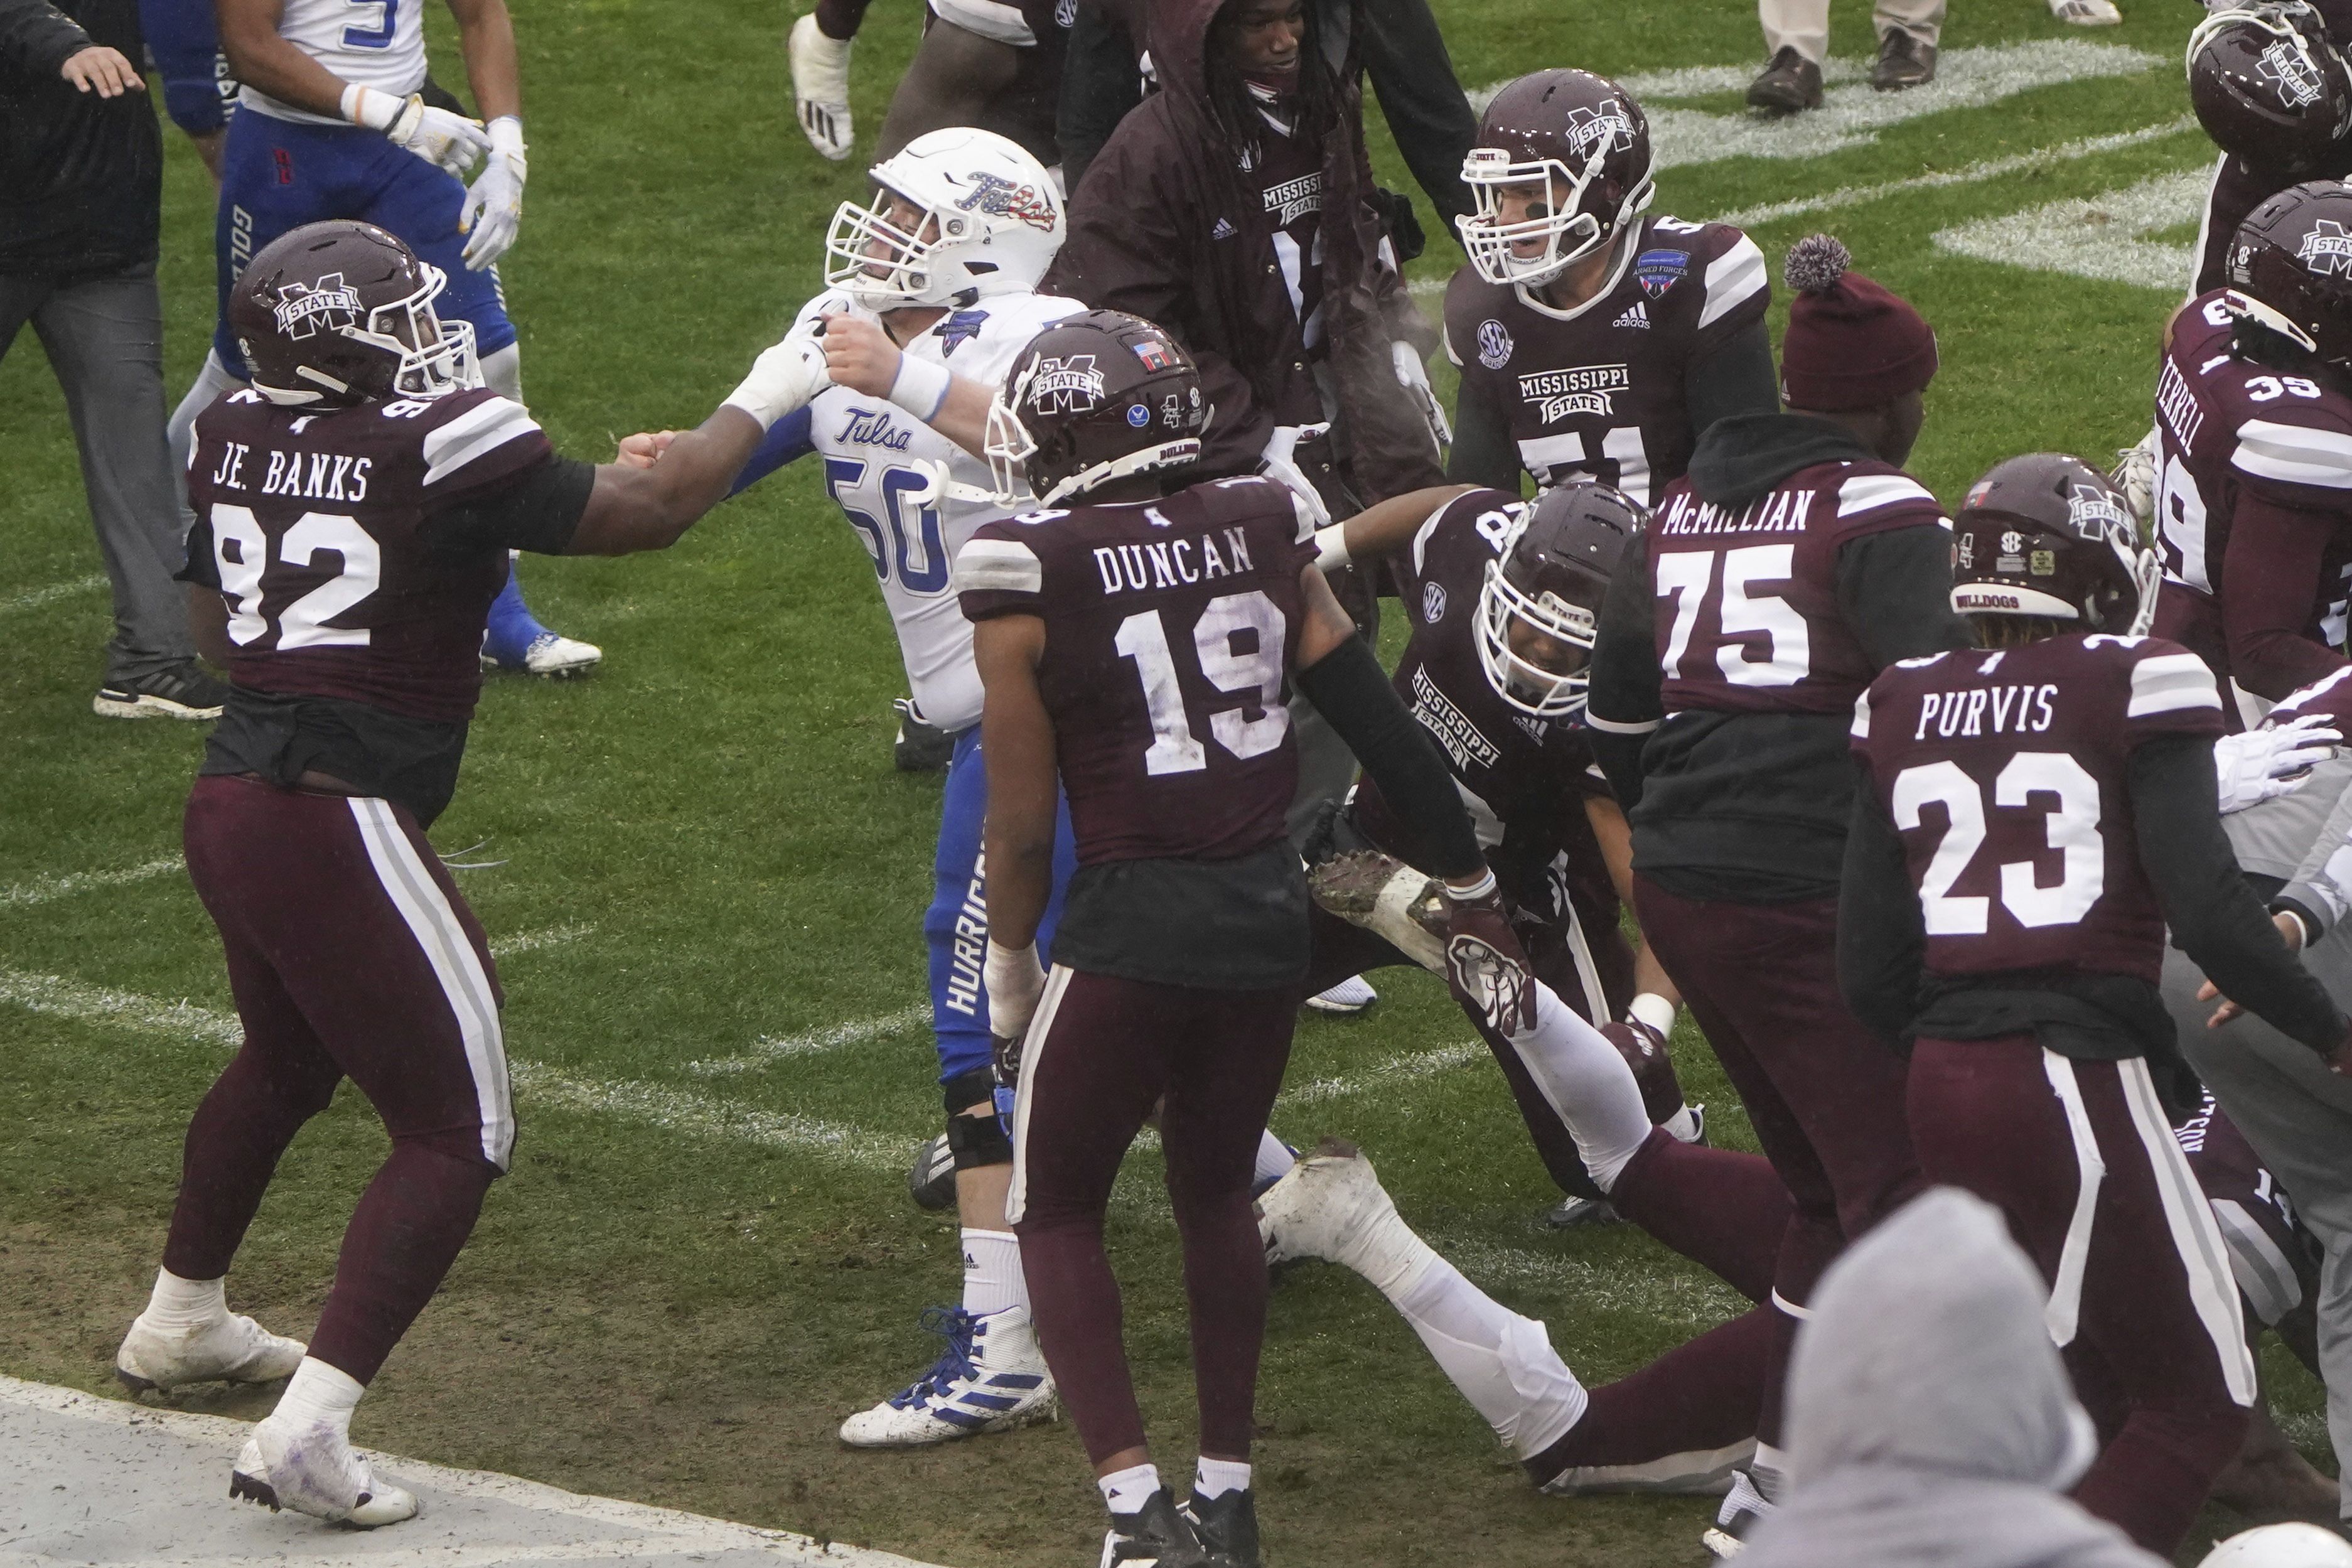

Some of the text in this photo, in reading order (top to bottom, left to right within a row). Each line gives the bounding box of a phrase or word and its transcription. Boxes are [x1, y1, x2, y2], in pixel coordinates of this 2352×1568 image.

[2274, 54, 2307, 93] STATE
[1581, 117, 1623, 140] STATE
[954, 171, 1057, 232] Tulsa
[2318, 239, 2352, 253] STA
[1633, 265, 1688, 276] ARMED FORCES
[290, 294, 345, 319] STATE
[1613, 318, 1651, 330] adidas
[1479, 321, 1507, 358] SEC
[1040, 373, 1087, 392] STATE
[1519, 368, 1630, 397] MISSISSIPPI
[1552, 396, 1599, 417] STATE
[834, 405, 914, 453] Tulsa
[213, 441, 372, 503] JE. BANKS
[824, 454, 952, 596] 50
[2085, 503, 2129, 527] STATE
[210, 502, 381, 651] 92
[1093, 526, 1254, 595] DUNCAN
[1657, 543, 1810, 687] 75
[1114, 590, 1290, 776] 19
[1414, 666, 1500, 766] MISSISSIPPI
[1420, 711, 1461, 759] STATE
[1914, 684, 2059, 741] PURVIS
[1892, 752, 2105, 935] 23
